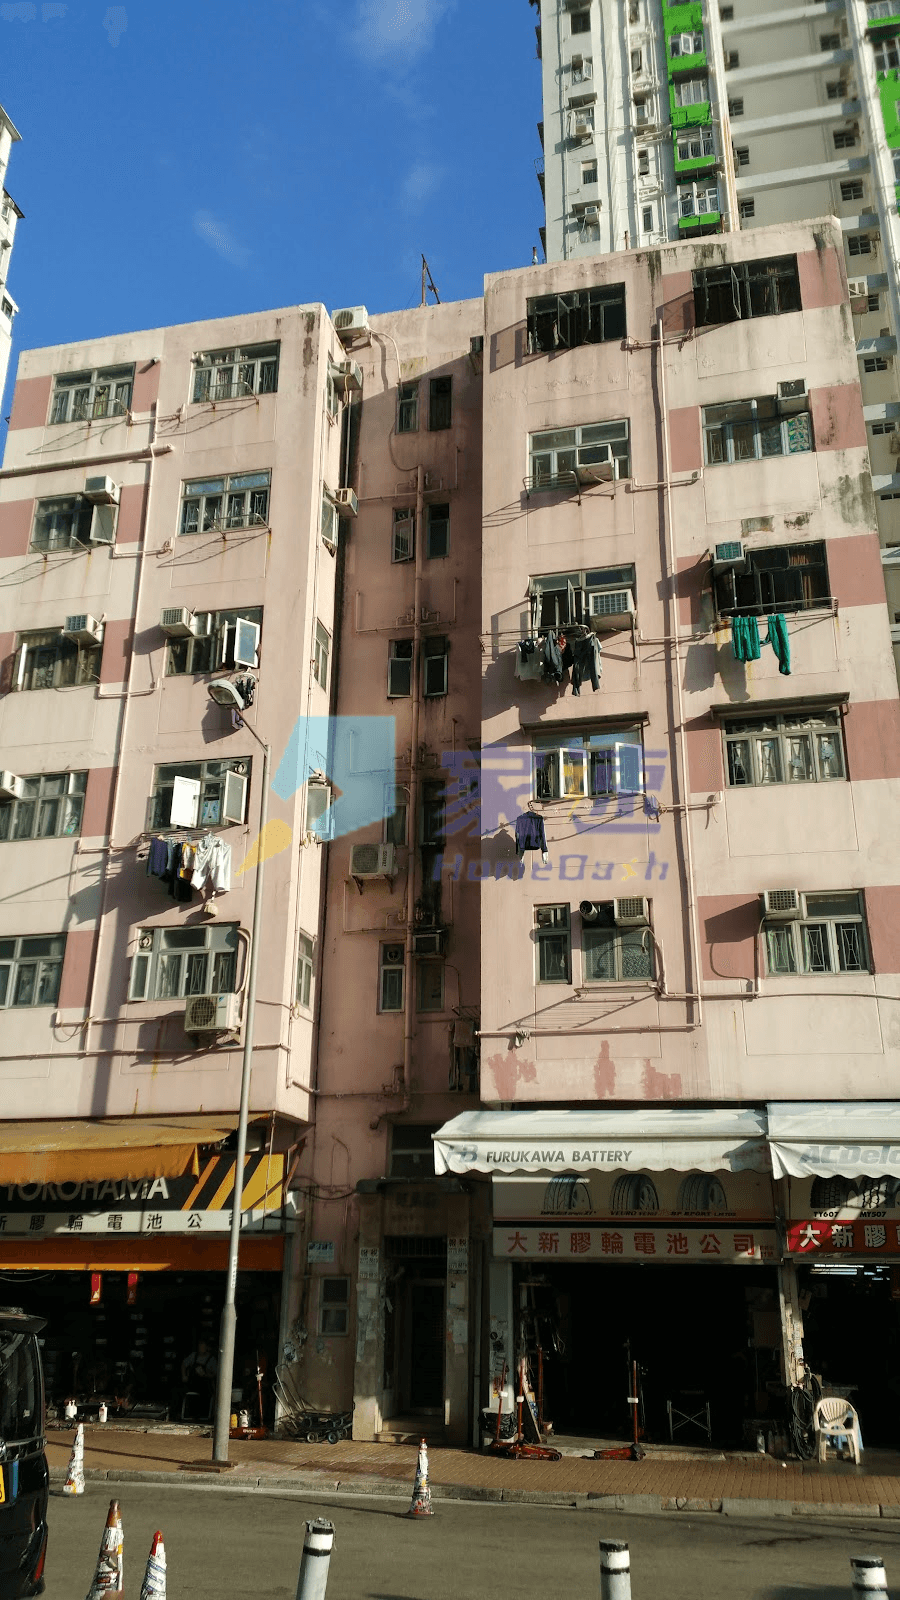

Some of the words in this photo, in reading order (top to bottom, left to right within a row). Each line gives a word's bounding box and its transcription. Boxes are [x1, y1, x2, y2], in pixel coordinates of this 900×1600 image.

[487, 1150, 565, 1164] FURUKAWA
[571, 1150, 633, 1163] BATTERY
[507, 1231, 756, 1256] 大新膠輪電池公司
[798, 1223, 900, 1249] 大新膠
